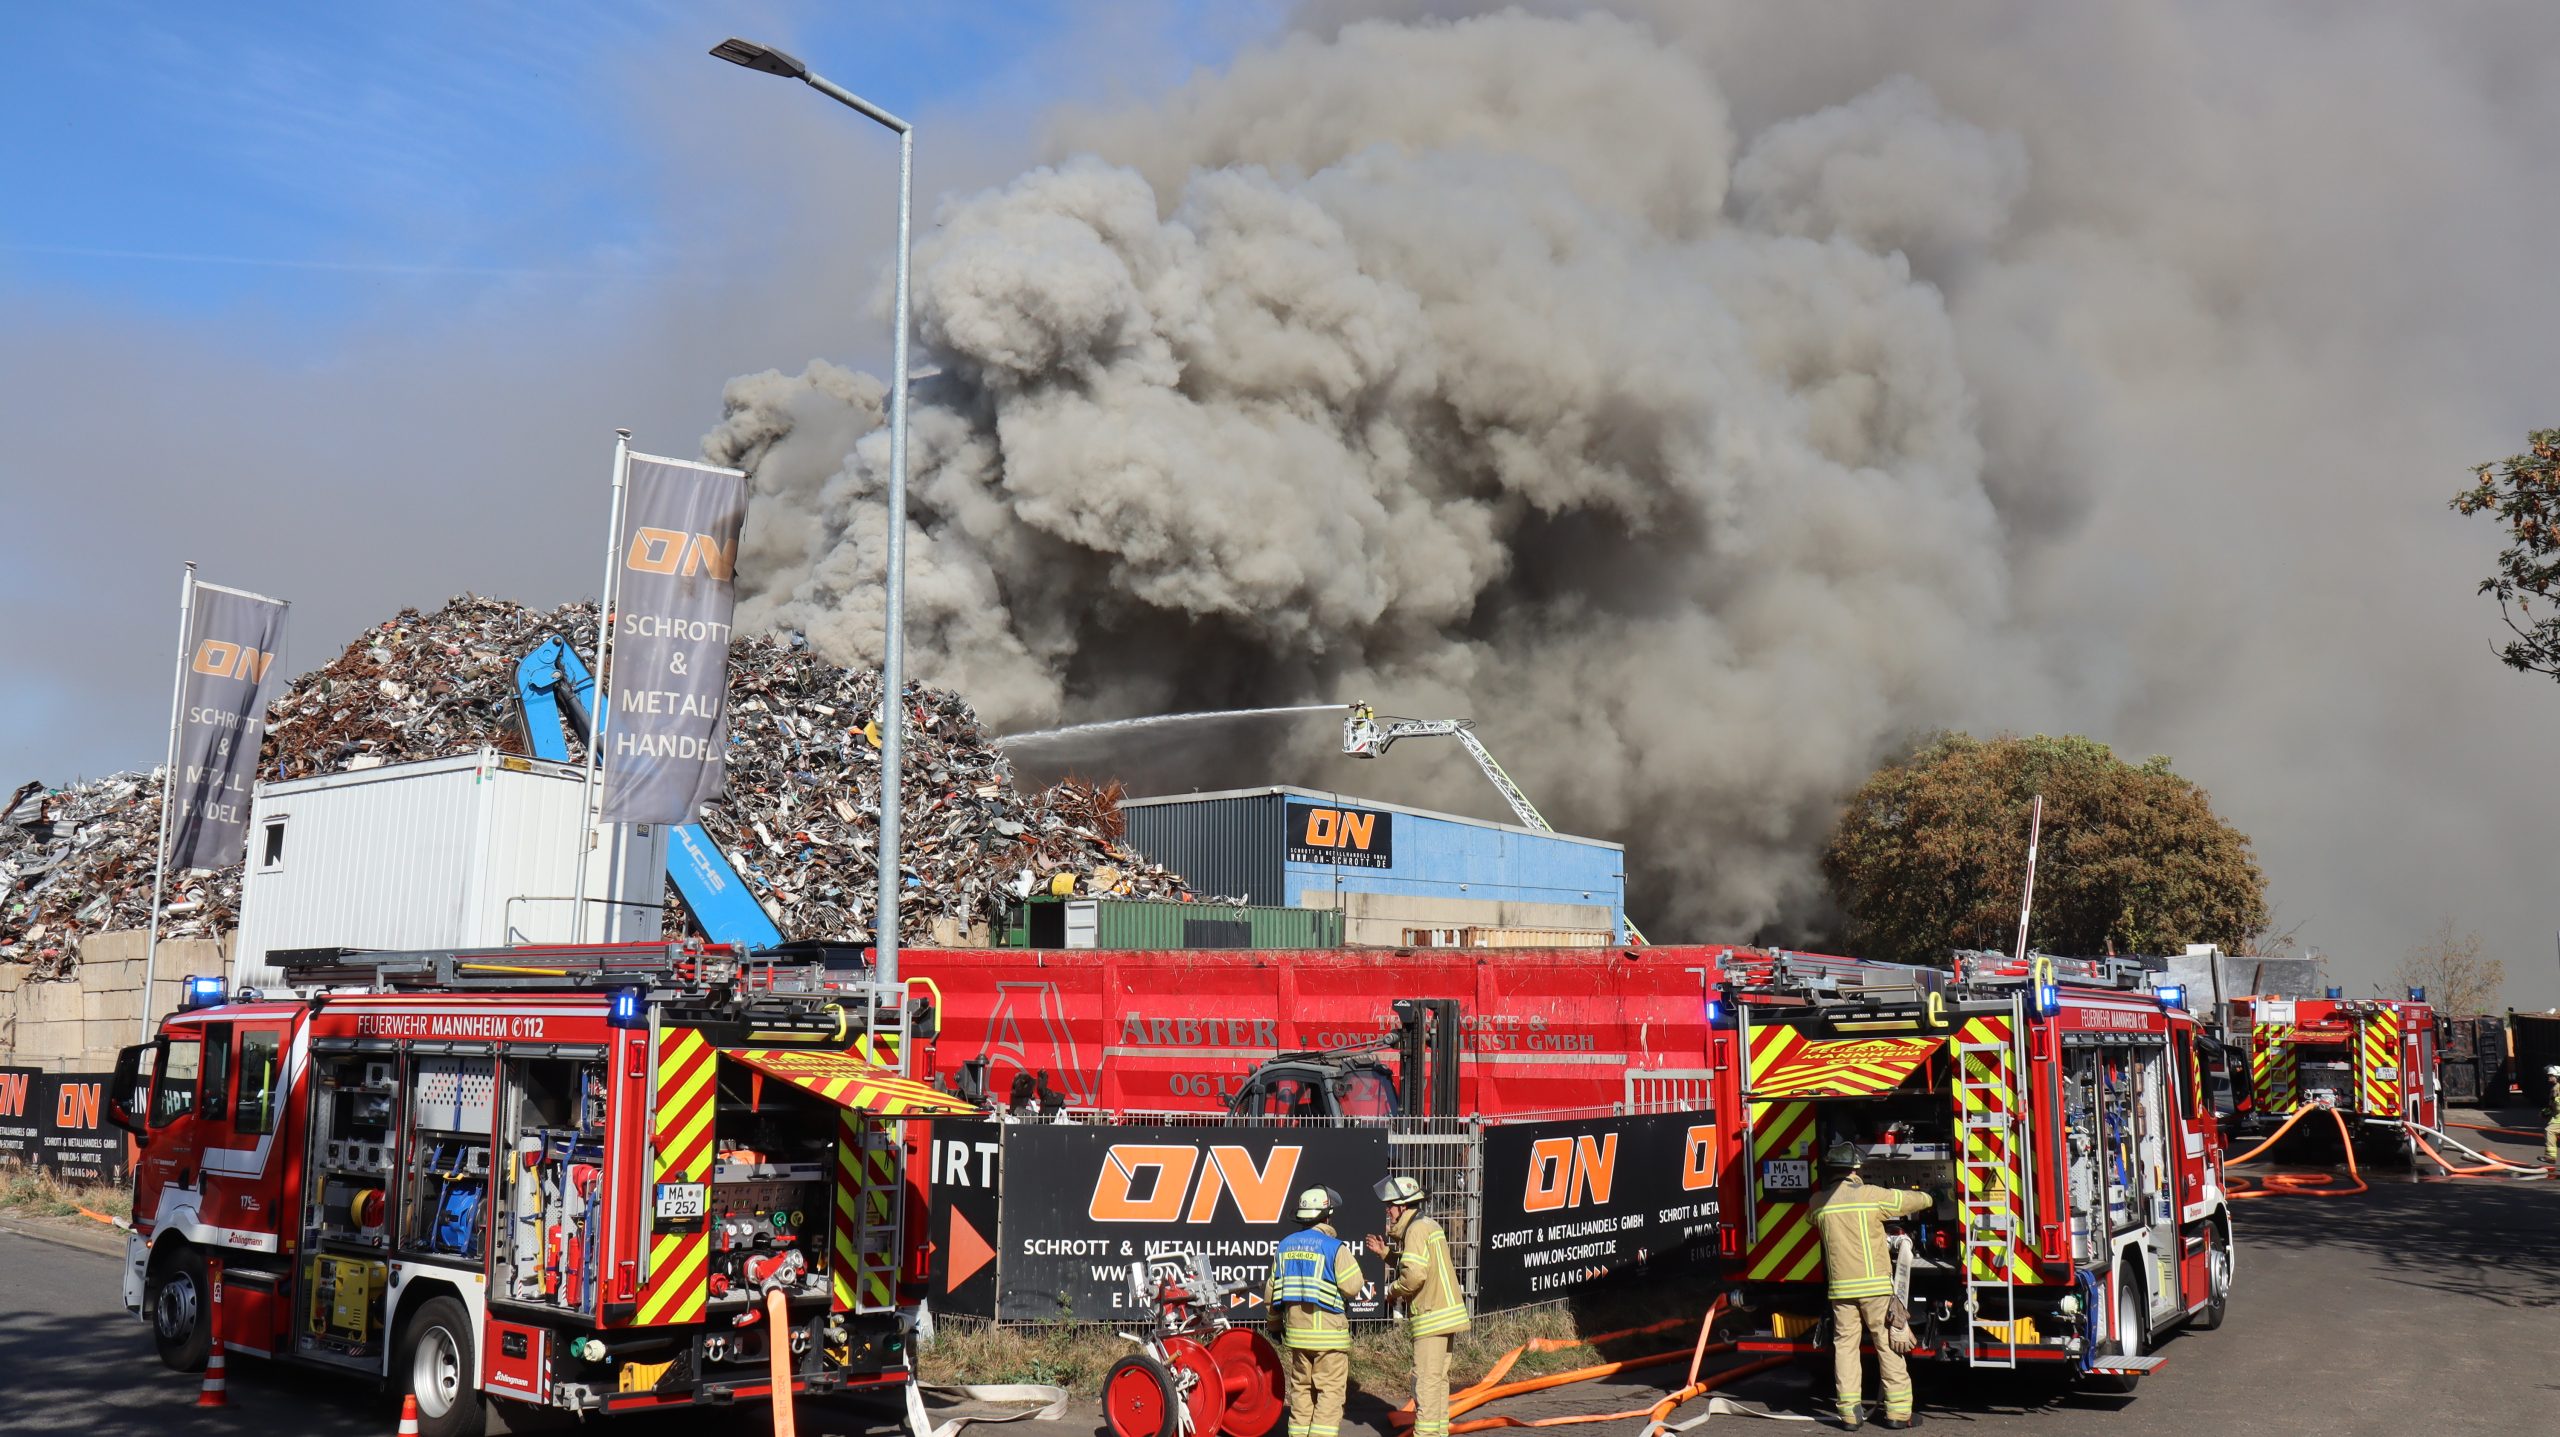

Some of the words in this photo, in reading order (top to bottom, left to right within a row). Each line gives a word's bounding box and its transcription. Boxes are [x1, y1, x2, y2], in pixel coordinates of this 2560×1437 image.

[626, 526, 737, 582] ON
[624, 613, 731, 645] SCHROTT
[192, 639, 274, 685] ON
[669, 651, 688, 676] &
[217, 737, 229, 757] &
[617, 732, 719, 762] HANDEL
[1306, 808, 1376, 850] ON
[1290, 847, 1315, 855] SCHROTT
[357, 1015, 427, 1035] FEUERWEHR
[431, 1016, 507, 1038] MANNHEIM
[1528, 1013, 1548, 1031] &
[2081, 1008, 2111, 1028] FEUERWEHR
[1118, 1011, 1278, 1047] ARBTER
[1526, 1034, 1595, 1051] GMBH
[1807, 1044, 1929, 1054] FEUERWEHR
[1801, 1050, 1922, 1060] MANNHEIM
[56, 1083, 101, 1130] ON
[44, 1137, 62, 1148] SCHROTT
[63, 1138, 67, 1148] &
[68, 1138, 103, 1149] METALLHANDELS
[103, 1139, 118, 1149] GMBH
[57, 1151, 102, 1164] WWW.ON-SHROTT.DE
[1523, 1132, 1619, 1213] ON
[1773, 1162, 1789, 1174] MA
[1088, 1143, 1303, 1225] ON
[1770, 1175, 1778, 1187] F
[1780, 1174, 1802, 1187] 251
[668, 1186, 684, 1200] MA
[664, 1201, 672, 1215] F
[675, 1200, 697, 1215] 252
[1659, 1205, 1691, 1224] SCHROTT
[1692, 1204, 1699, 1218] &
[1491, 1229, 1534, 1250] SCHROTT
[1537, 1228, 1544, 1243] &
[1548, 1217, 1618, 1241] METALLHANDELS
[1620, 1213, 1644, 1230] GMBH
[1023, 1238, 1110, 1256] SCHROTT
[1119, 1239, 1134, 1257] &
[1523, 1239, 1617, 1269] WWW.ON-SCHROTT.DE
[1531, 1268, 1583, 1292] EINGANG
